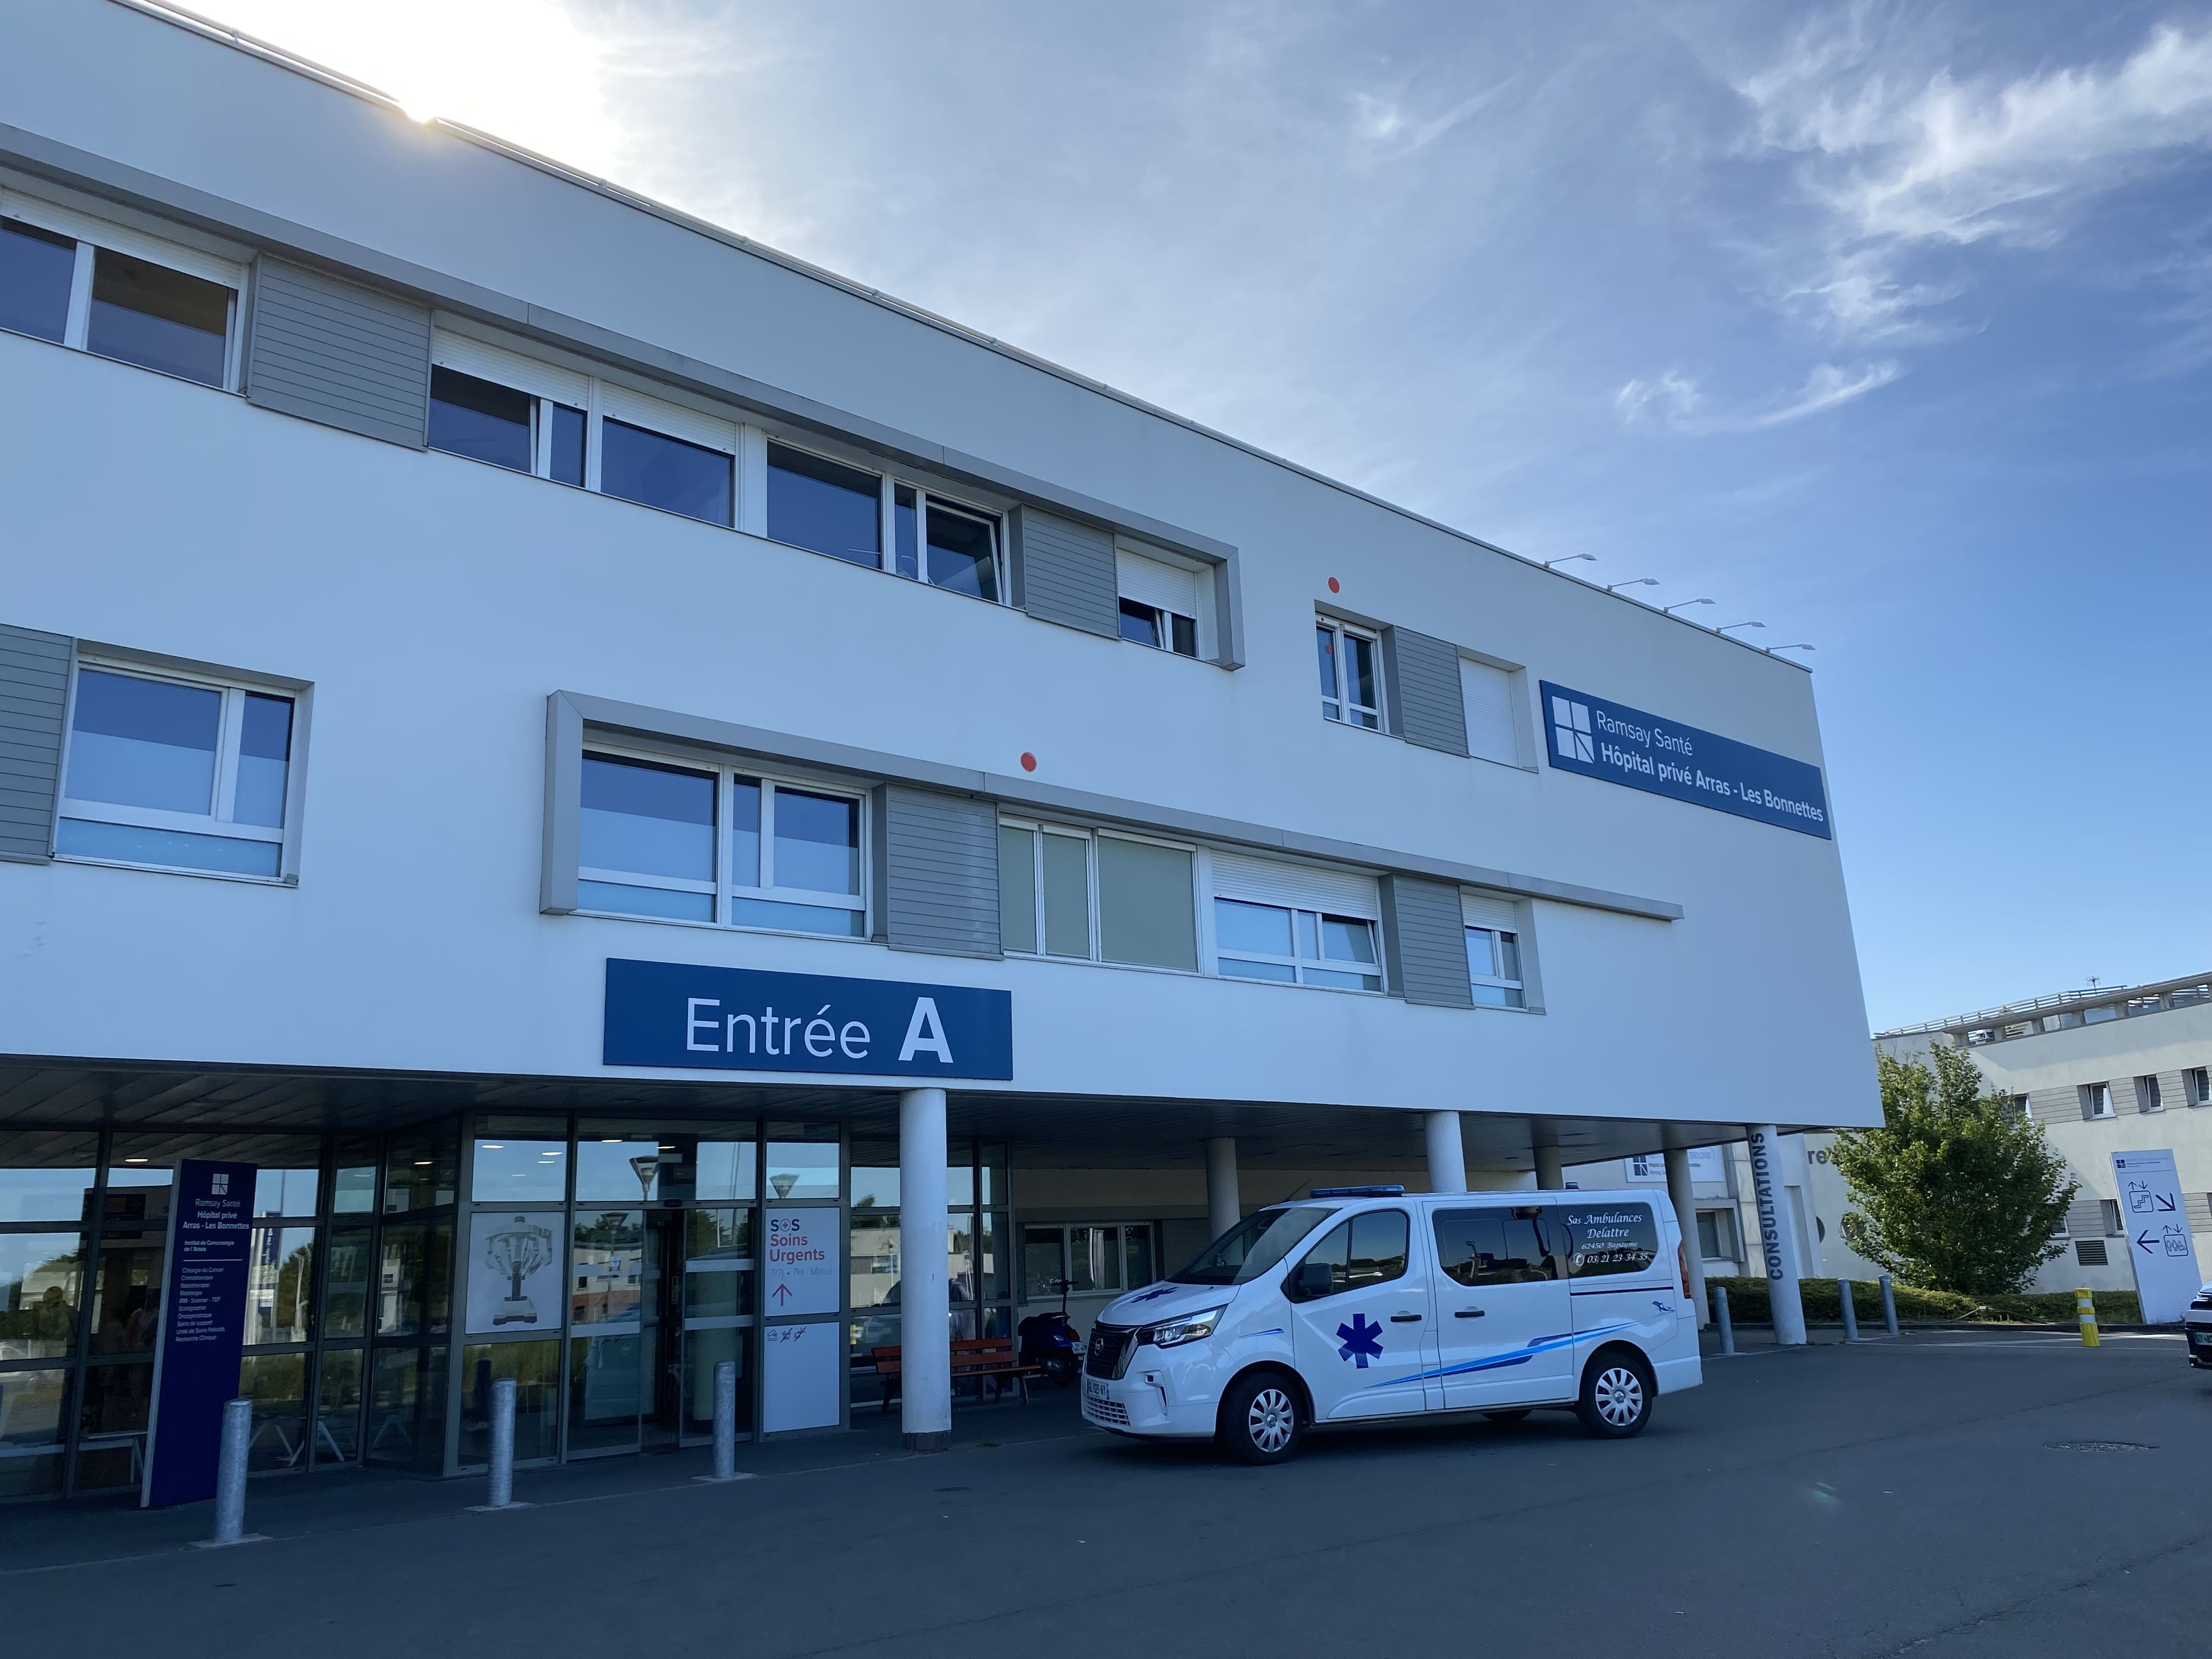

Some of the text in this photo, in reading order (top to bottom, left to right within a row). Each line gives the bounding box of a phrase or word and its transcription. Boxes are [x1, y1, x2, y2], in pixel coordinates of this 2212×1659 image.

[1596, 709, 1693, 756] Ramsay Santé
[1601, 742, 1654, 775] Hôpital
[1658, 761, 1692, 785] privé
[1696, 769, 1730, 796] Arras
[1740, 782, 1762, 805] Les
[1764, 789, 1824, 822] Bonnettes
[686, 996, 954, 1063] Entrée A
[195, 1198, 241, 1209] Ramsay Santé
[1751, 1132, 1784, 1280] CONSULTATIONS
[198, 1211, 237, 1220] Hôpital privé
[1567, 1211, 1643, 1225] Sas Ambulances
[770, 1218, 800, 1232] SOS
[770, 1233, 808, 1246] Soins
[1587, 1227, 1629, 1239] Delattre
[1607, 1241, 1638, 1250] Bapaume
[770, 1249, 825, 1265] Urgents
[1587, 1255, 1598, 1263] 03
